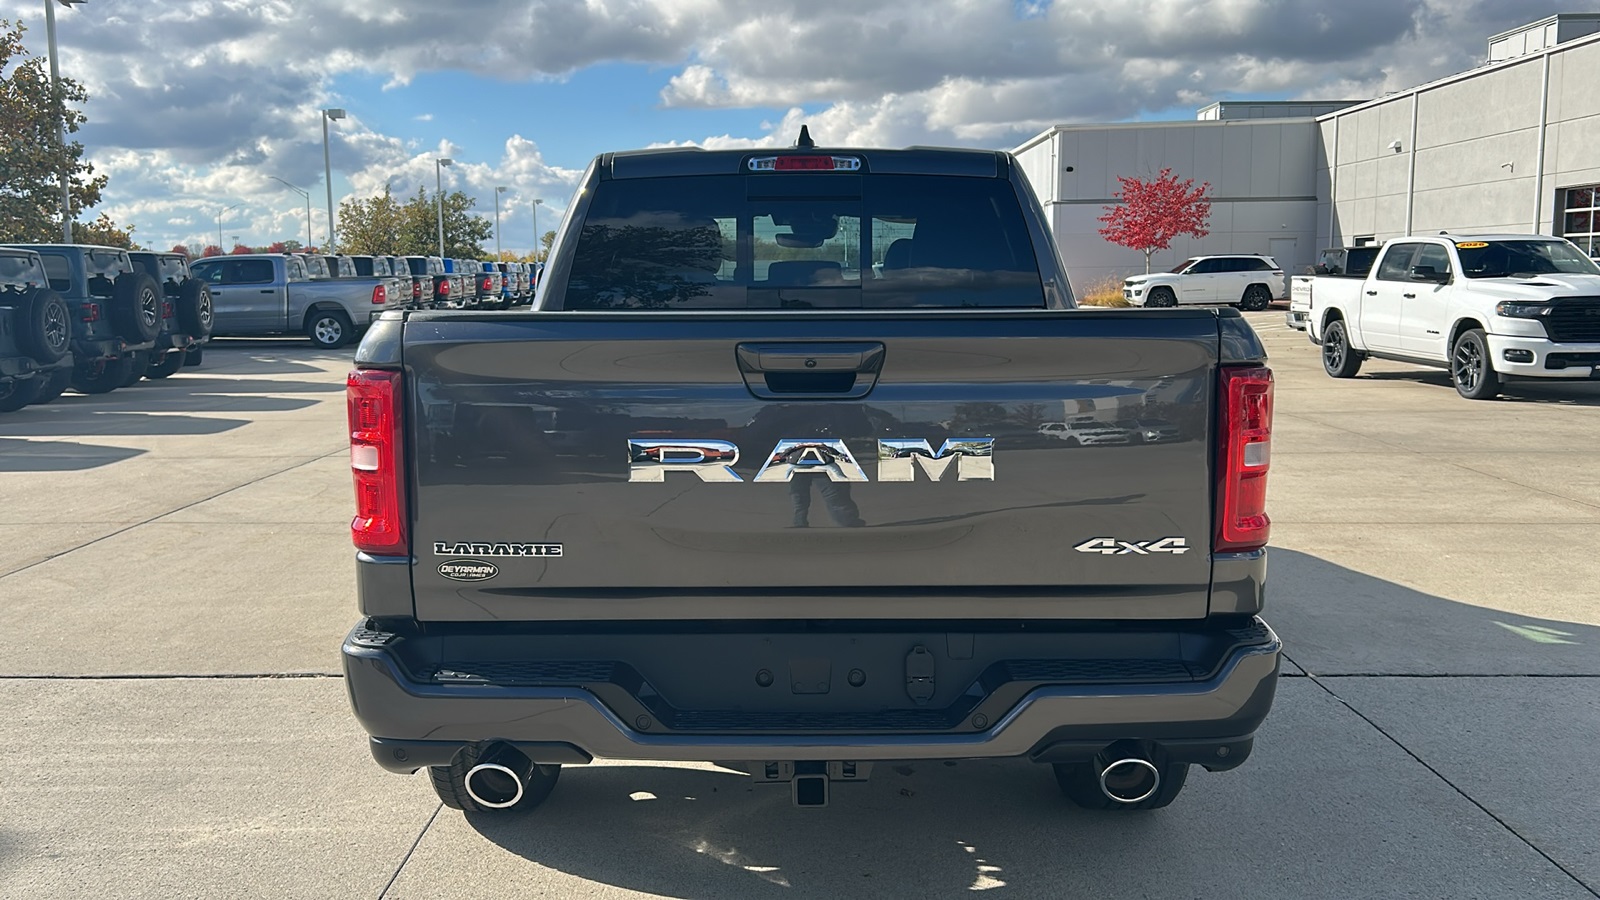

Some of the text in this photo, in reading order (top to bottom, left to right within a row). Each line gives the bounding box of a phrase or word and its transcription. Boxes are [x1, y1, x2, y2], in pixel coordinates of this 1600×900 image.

[627, 438, 996, 483] RAM
[434, 542, 563, 557] LARAMIE
[1073, 537, 1191, 555] 4x4
[441, 565, 494, 574] DEYARMAN
